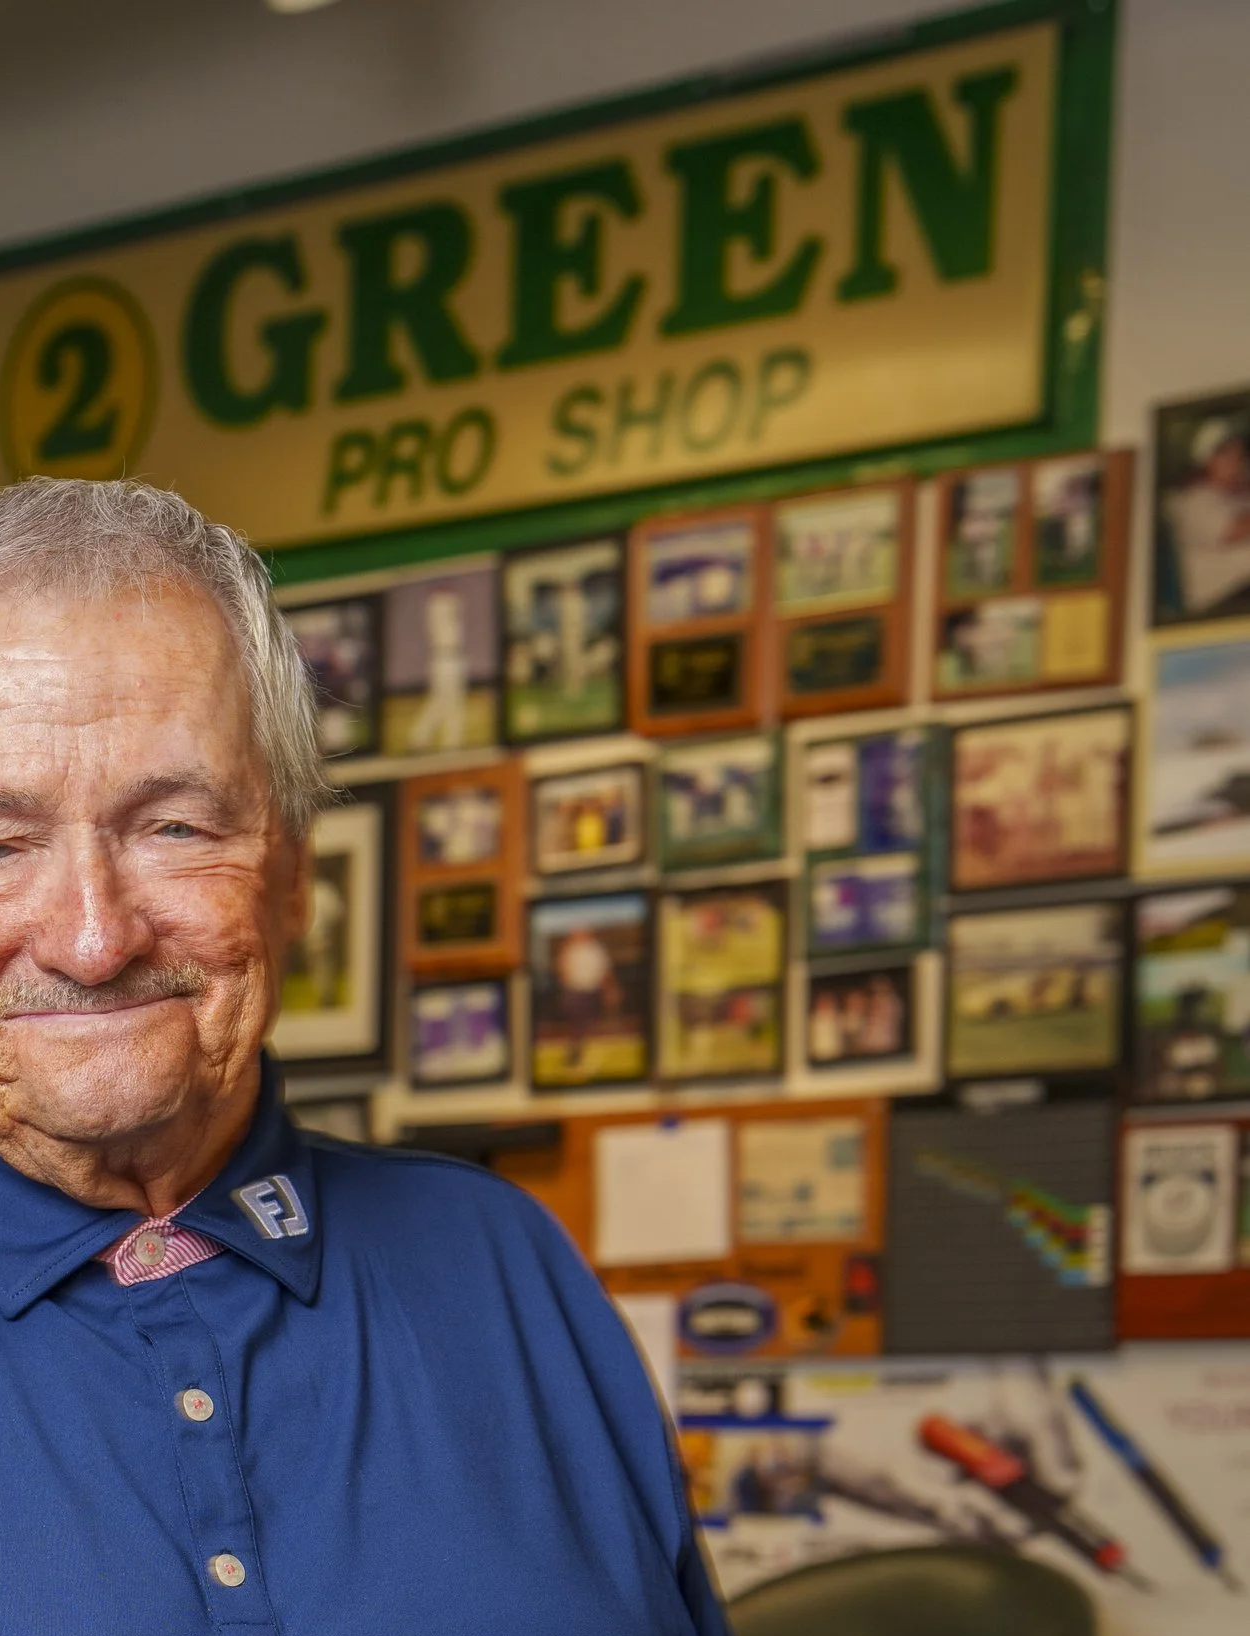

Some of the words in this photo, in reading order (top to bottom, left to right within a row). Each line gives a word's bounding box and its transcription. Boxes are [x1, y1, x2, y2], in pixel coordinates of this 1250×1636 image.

[36, 321, 118, 461] 2
[182, 64, 1020, 430] GREEN
[322, 407, 497, 517] PRO
[546, 348, 813, 476] SHOP
